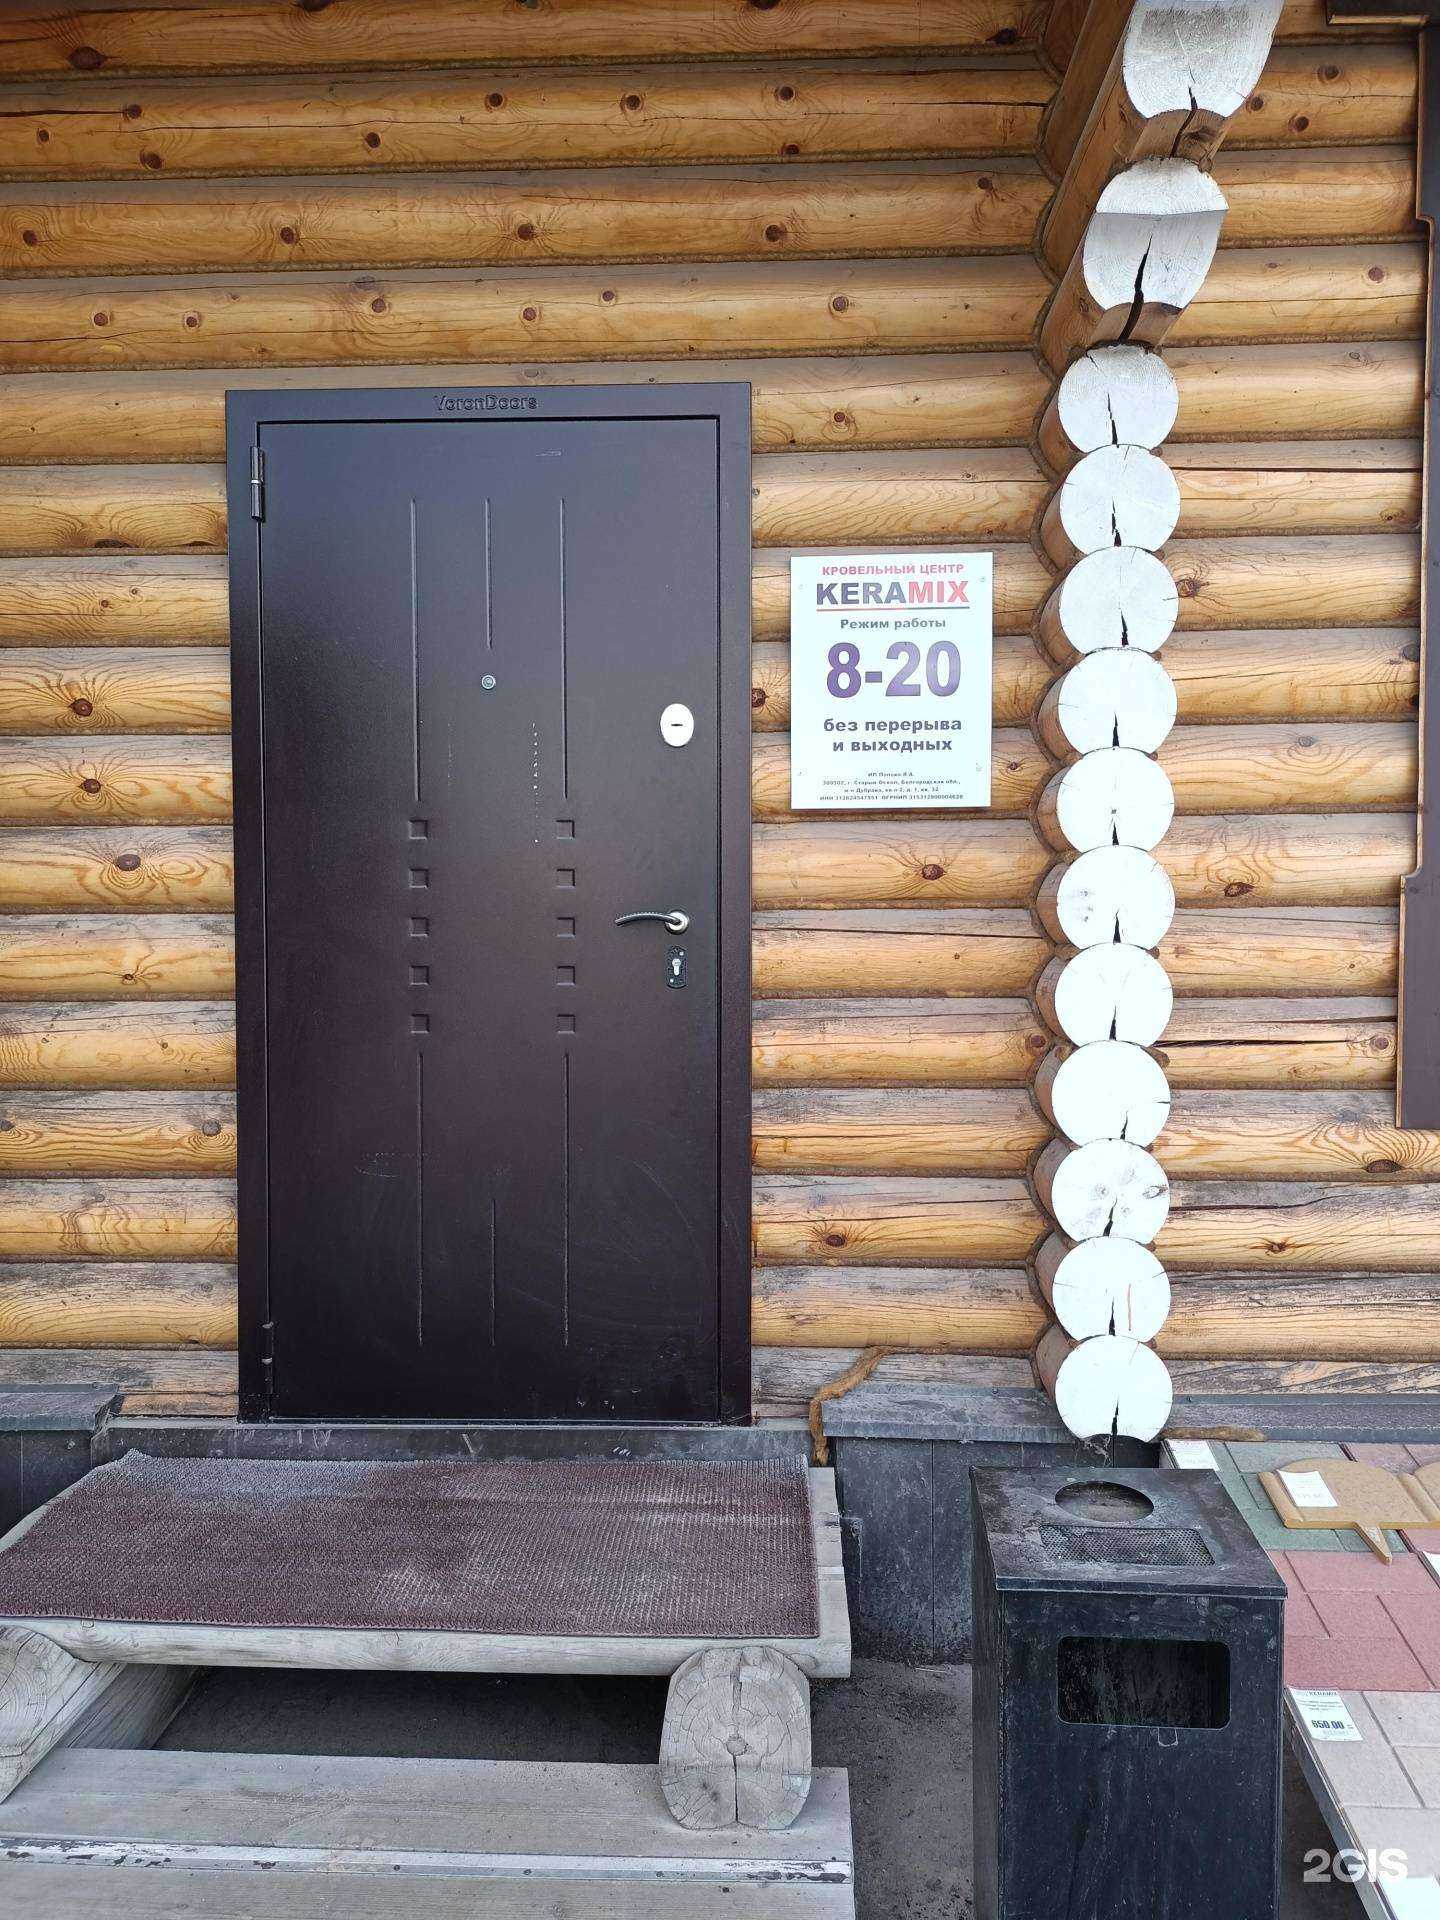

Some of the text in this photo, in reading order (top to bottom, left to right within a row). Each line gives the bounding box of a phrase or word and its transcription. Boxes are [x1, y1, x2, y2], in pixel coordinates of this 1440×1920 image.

[434, 395, 537, 411] VoronDoors
[919, 563, 965, 575] ЦЕНТР
[816, 580, 969, 606] KERAMIX
[840, 617, 946, 630] Режим работы
[826, 640, 962, 699] 8-20
[823, 718, 962, 734] без перерыва
[832, 740, 953, 753] и выходных
